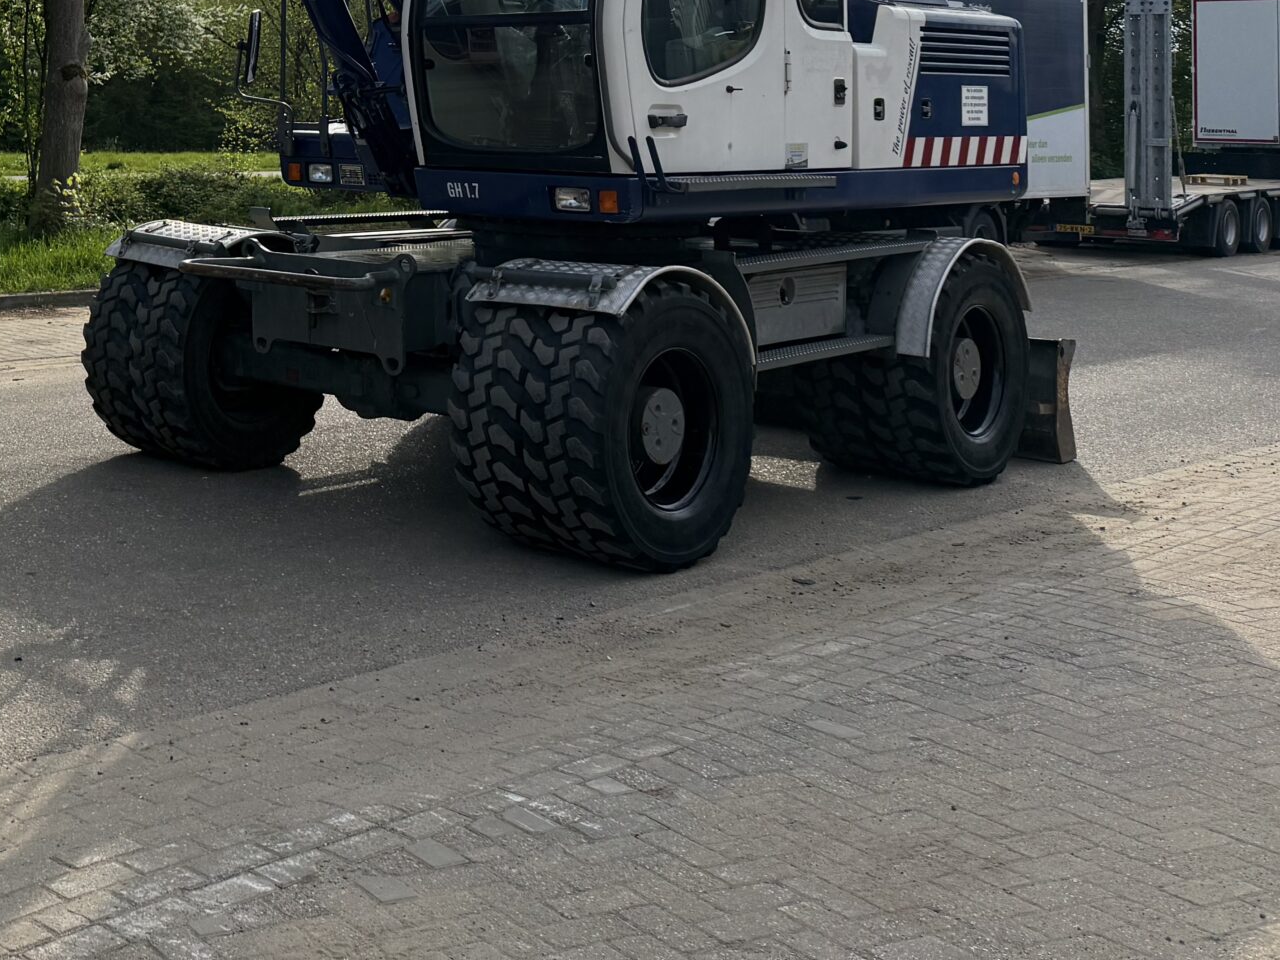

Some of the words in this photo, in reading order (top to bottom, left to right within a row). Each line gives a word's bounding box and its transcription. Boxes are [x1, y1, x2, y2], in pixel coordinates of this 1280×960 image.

[891, 135, 900, 157] The
[897, 97, 907, 134] power
[903, 80, 912, 95] of
[447, 182, 463, 198] GH
[464, 183, 479, 199] 1.7
